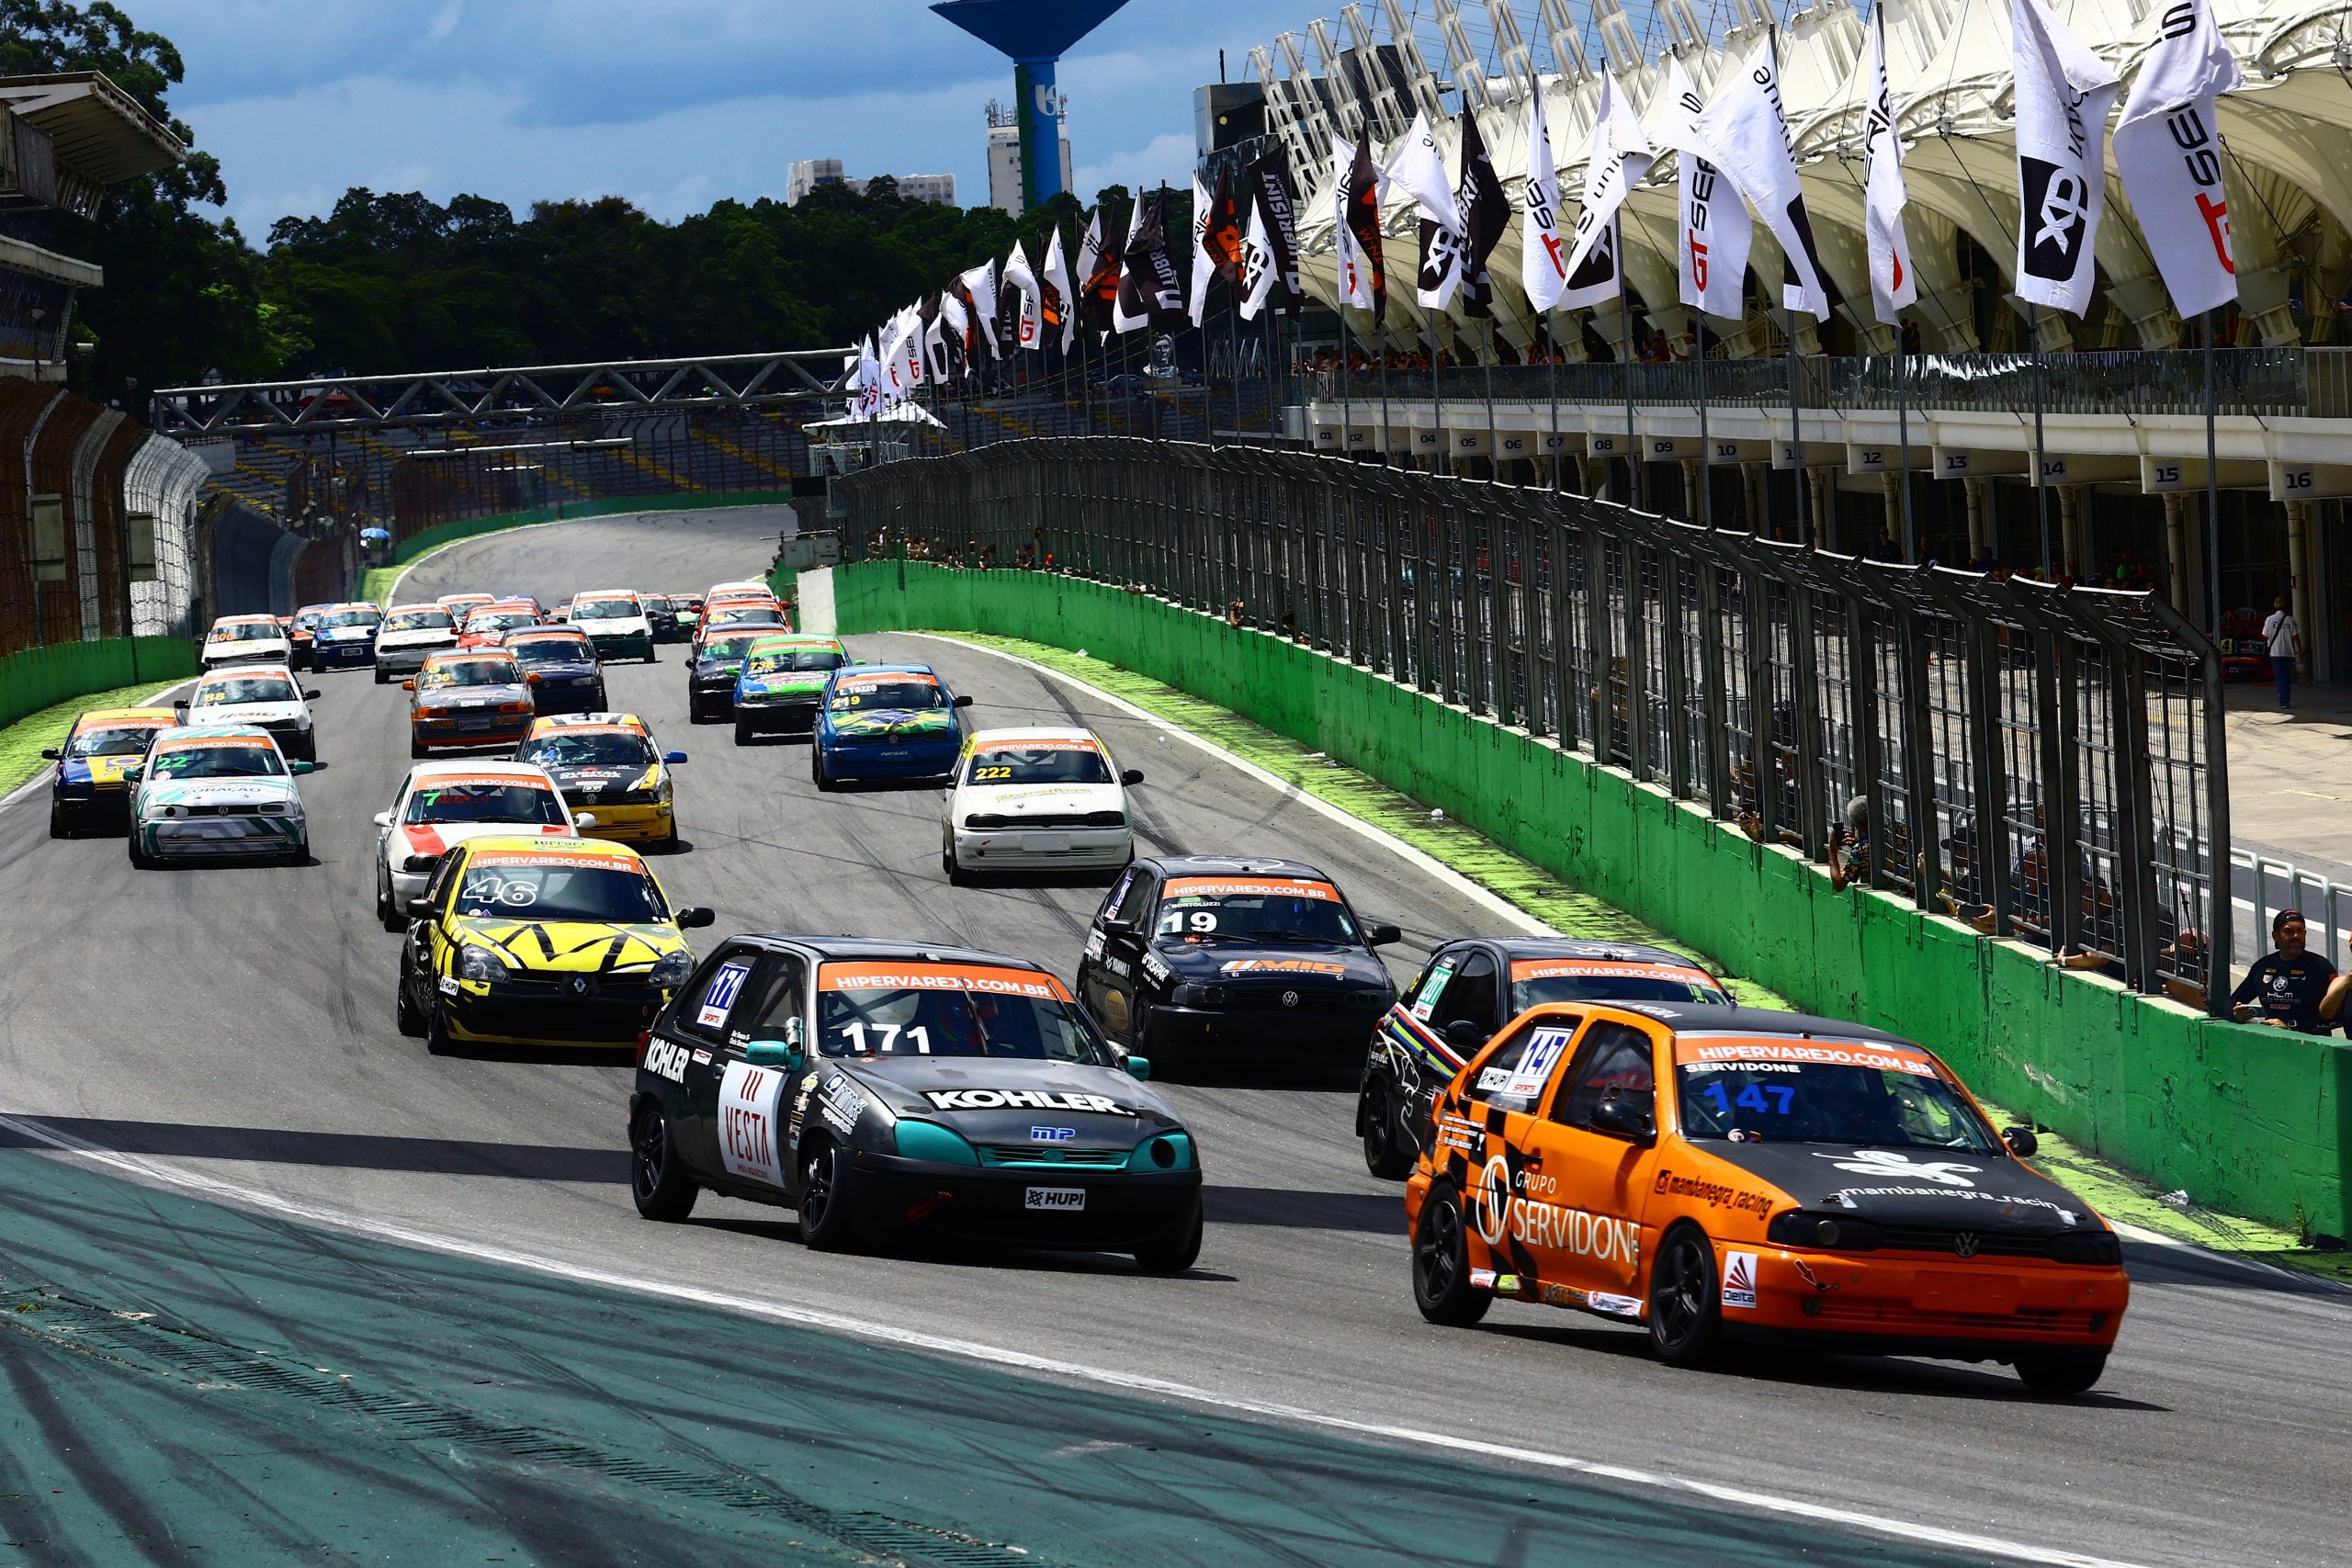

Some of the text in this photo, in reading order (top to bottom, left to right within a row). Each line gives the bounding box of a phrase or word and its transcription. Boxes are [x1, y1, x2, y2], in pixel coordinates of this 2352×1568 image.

[1689, 228, 1709, 292] GT
[1020, 315, 1035, 343] GT
[1319, 432, 1332, 440] 01
[1350, 434, 1363, 442] 02
[1420, 434, 1436, 443] 04
[1461, 438, 1476, 446] 05
[1505, 439, 1521, 449] 06
[1594, 440, 1613, 450] 08
[1655, 442, 1673, 453] 09
[1718, 446, 1736, 456] 10
[1863, 452, 1883, 464] 12
[1947, 456, 1967, 469] 13
[2043, 461, 2065, 476] 14
[2156, 467, 2179, 482] 15
[2286, 472, 2312, 489] 16
[426, 673, 450, 683] 136
[163, 741, 264, 753] HIPERVAREJO.COM.BR
[985, 743, 1094, 753] HIPERVAREJO.COM.BR
[155, 756, 188, 770] 22
[975, 766, 1012, 781] 222
[426, 779, 546, 789] HIPERVAREJO.COM.BR
[422, 791, 441, 807] 7
[477, 856, 633, 872] HIPERVAREJO.COM.BR
[461, 876, 539, 908] 46
[1174, 885, 1327, 898] HIPERVAREJO.COM.BR
[1171, 901, 1221, 909] BORTOLUZZI
[1163, 911, 1218, 933] 19
[1531, 966, 1712, 987] HIPERVAREJO.COM.BR
[709, 969, 745, 1008] 171
[835, 975, 1051, 998] HIPERVAREJO.COM.BR
[1423, 972, 1450, 1005] 207
[842, 1021, 931, 1055] 171
[644, 1037, 690, 1084] KOHLER
[1521, 1033, 1566, 1076] 147
[1698, 1045, 1935, 1077] HIPERVAREJO.COM.BR
[1685, 1062, 1802, 1074] SERVIDONE
[1703, 1081, 1796, 1115] 147
[725, 1105, 772, 1168] VESTA
[1516, 1170, 1556, 1194] GRUPO
[1044, 1191, 1085, 1207] HUPI
[1668, 1175, 1774, 1222] mambanegra_racing
[1839, 1185, 2063, 1211] mambanegra_racin
[1512, 1198, 1640, 1266] SERVIDONE
[1722, 1290, 1756, 1304] Delta
